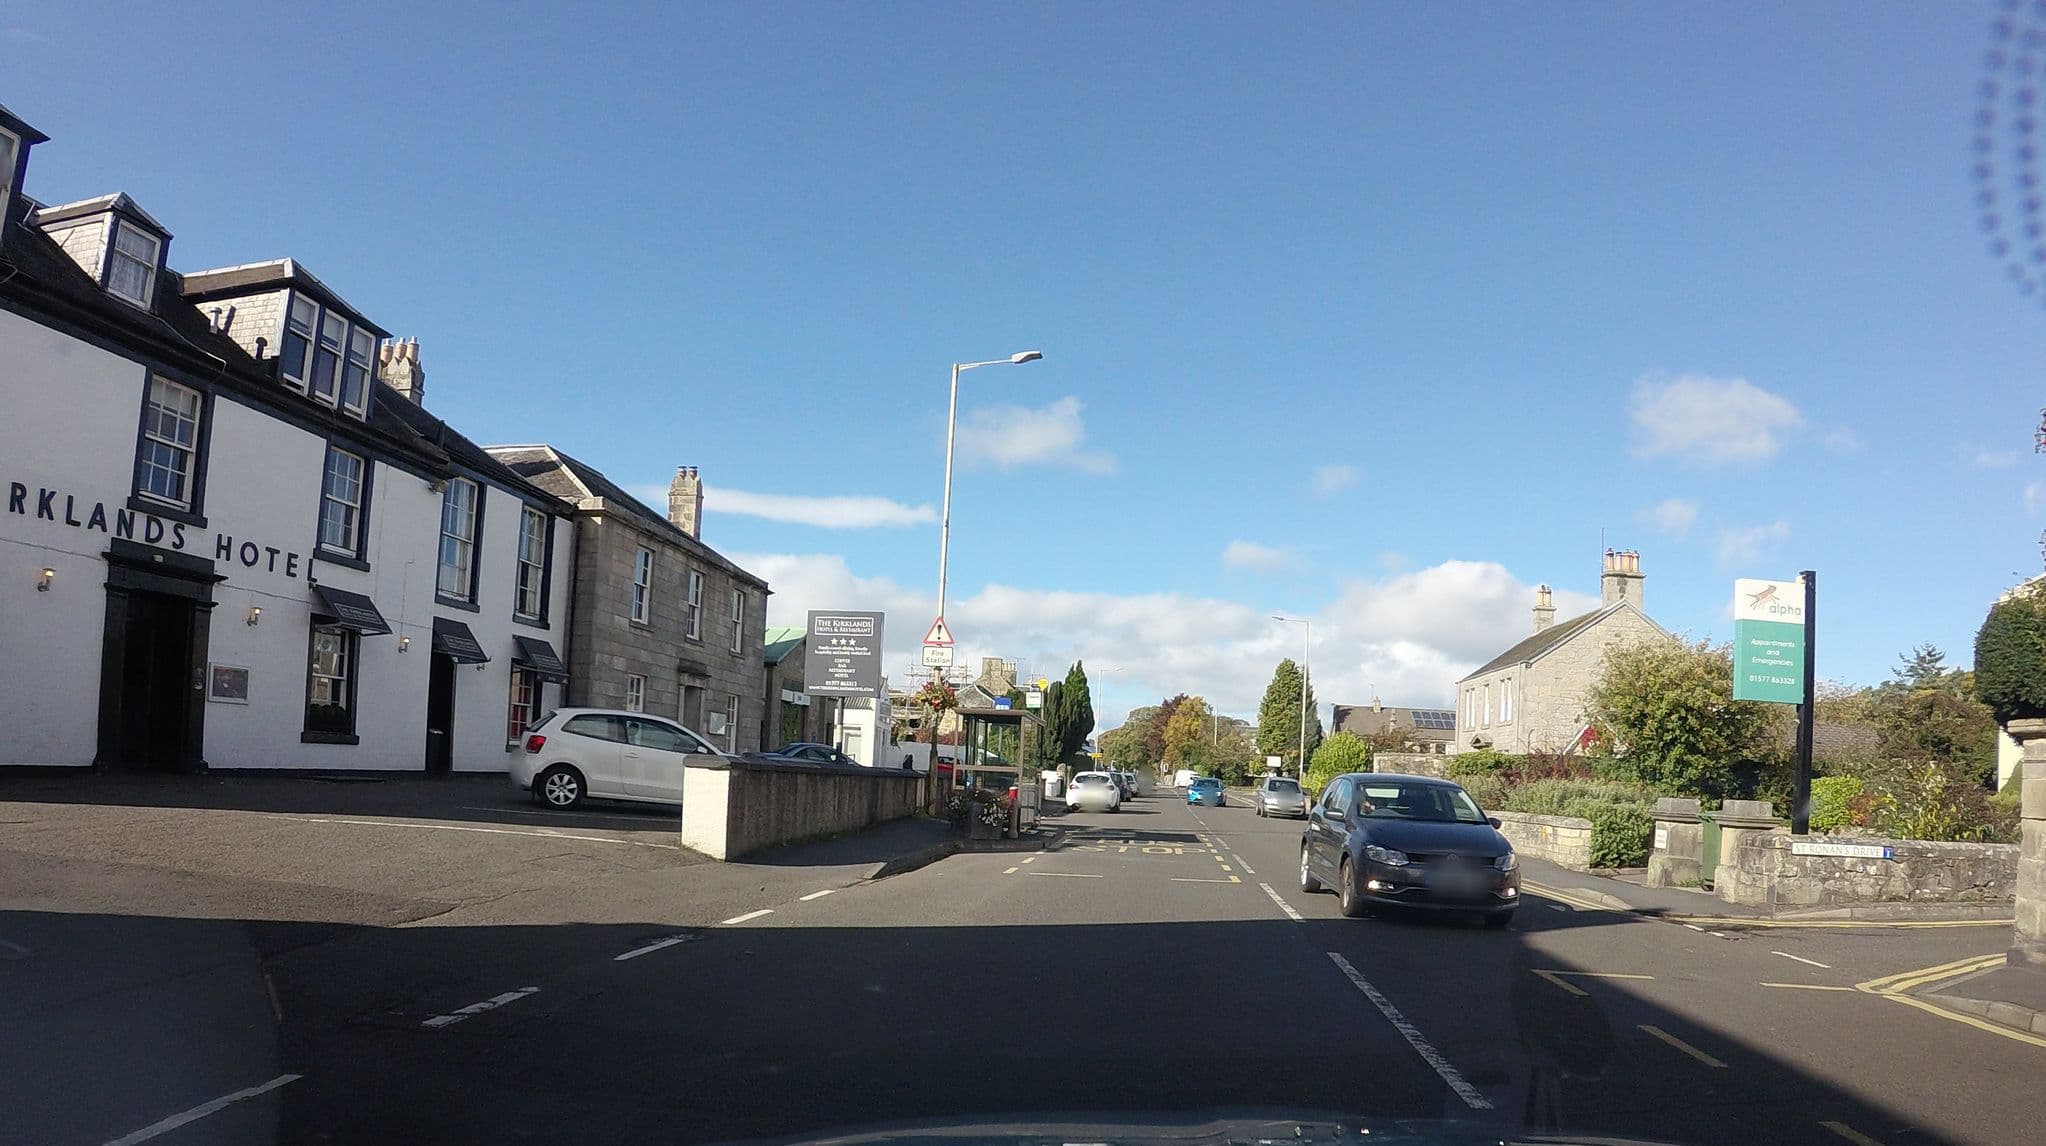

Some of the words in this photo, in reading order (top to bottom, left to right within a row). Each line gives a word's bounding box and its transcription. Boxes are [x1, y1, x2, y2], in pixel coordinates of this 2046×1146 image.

[9, 481, 186, 550] RKLANDS
[215, 533, 318, 582] HOTEL
[1769, 604, 1802, 616] alpha
[818, 619, 831, 627] THE
[833, 620, 871, 628] KIRKLANDS
[1751, 638, 1795, 648] Appointments
[1752, 656, 1793, 667] Emergencies
[1749, 675, 1770, 683] 01577
[1071, 845, 1206, 855] STOP
[1795, 844, 1807, 853] ST
[1853, 846, 1881, 857] DRIVE
